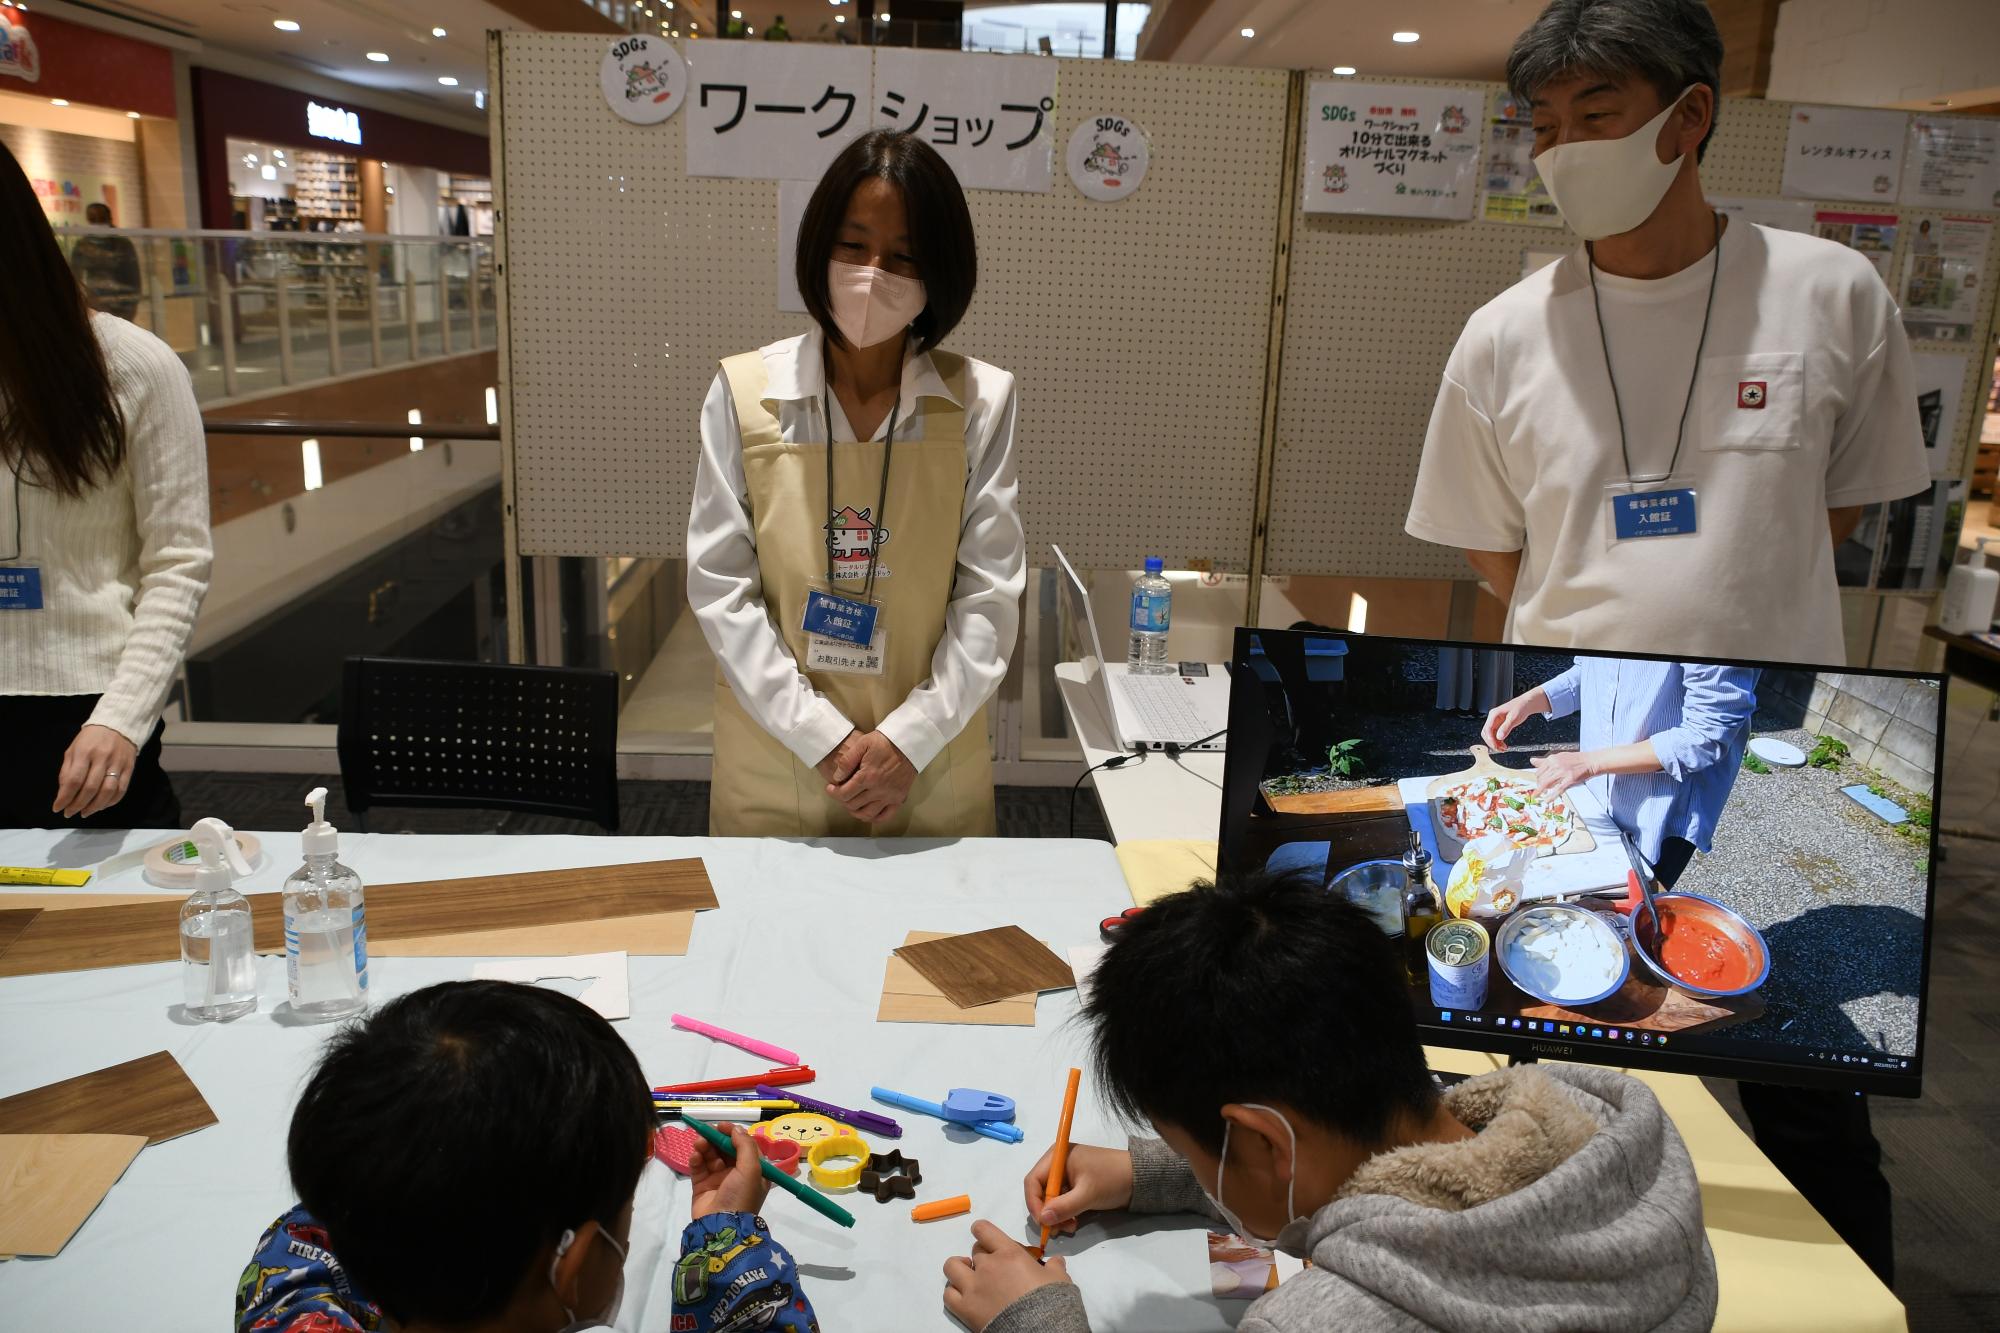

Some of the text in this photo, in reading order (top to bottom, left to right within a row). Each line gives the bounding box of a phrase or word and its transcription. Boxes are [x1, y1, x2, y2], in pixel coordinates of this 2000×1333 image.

[612, 38, 648, 61] SDGs
[700, 83, 1054, 151] ワークショップ
[1321, 105, 1356, 122] SDGs
[1095, 117, 1130, 137] SDGs
[1364, 119, 1419, 131] ワークショップ
[1352, 131, 1431, 147] 10分で出来る
[1339, 144, 1447, 164] オリジナルマグネット
[1801, 145, 1892, 160] レンタルオフィス
[1373, 162, 1405, 175] づくり
[823, 614, 853, 629] 入館証
[817, 654, 865, 669] お取引先さま
[1531, 1043, 1573, 1056] HUAWEI
[287, 1240, 351, 1296] FIRE ENGINE
[709, 1267, 769, 1325] PATROL CAR
